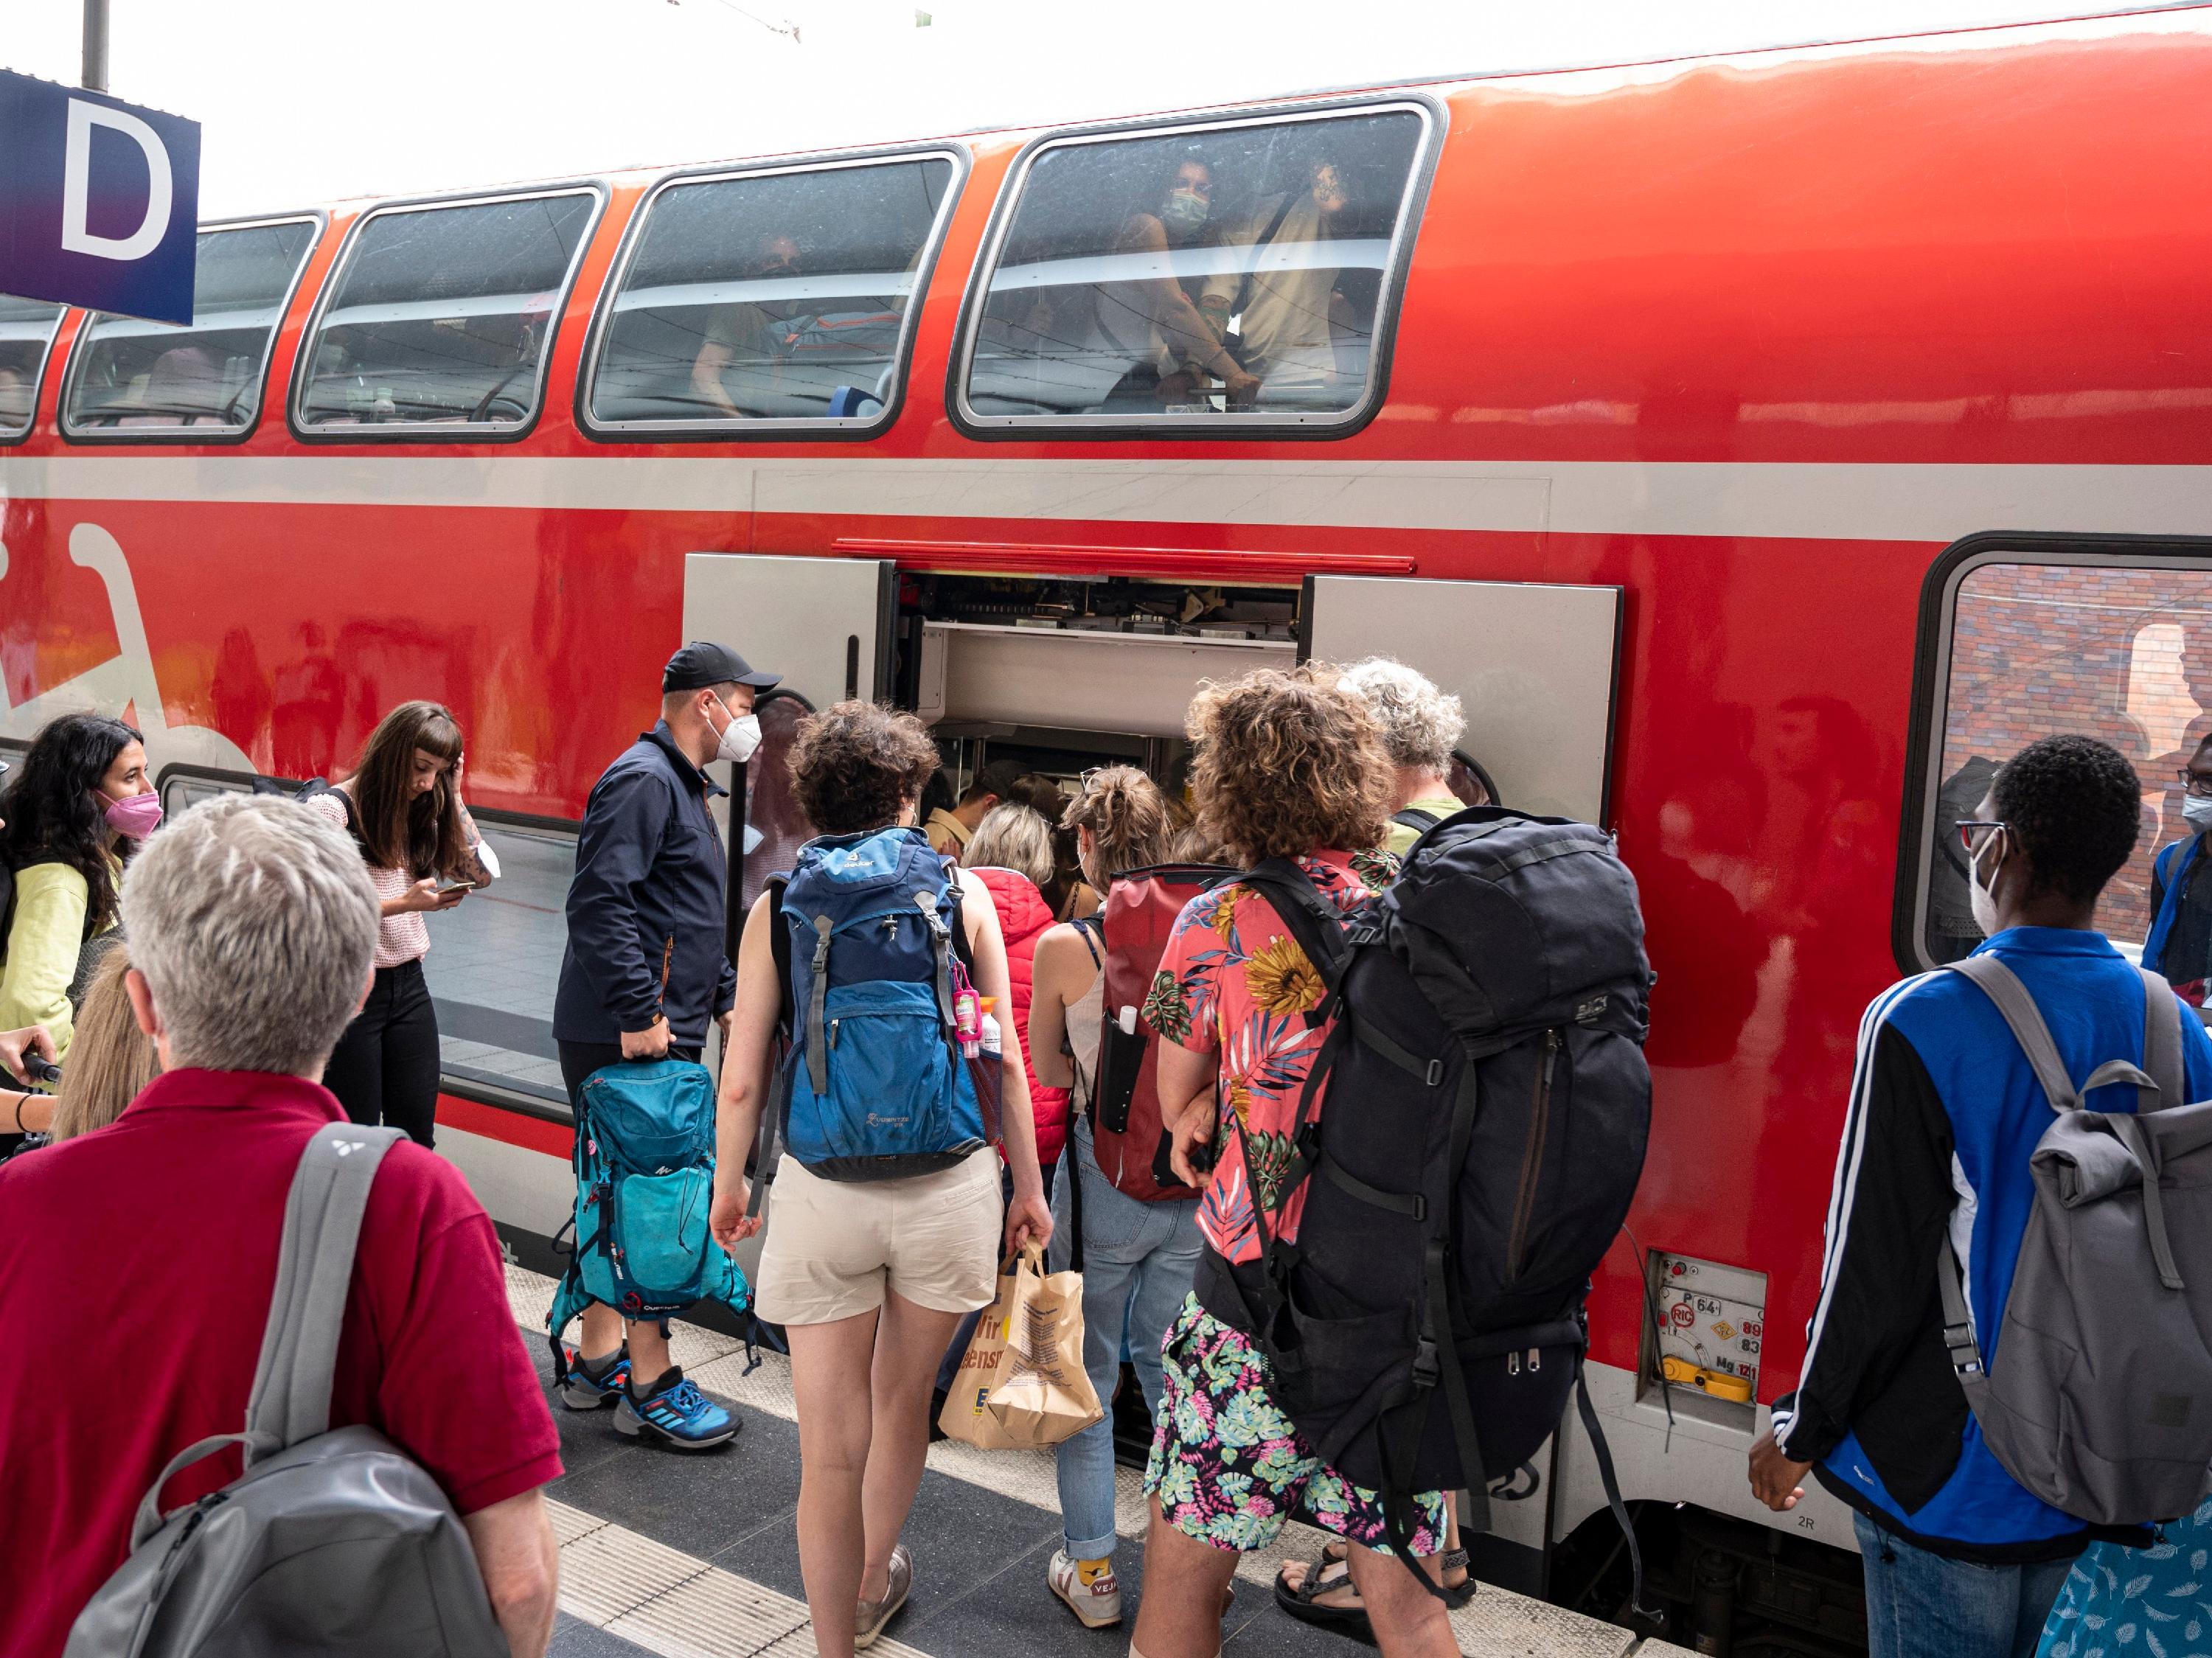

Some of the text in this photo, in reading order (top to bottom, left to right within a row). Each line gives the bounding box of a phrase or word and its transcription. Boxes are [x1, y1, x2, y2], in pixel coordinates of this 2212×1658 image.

[61, 97, 173, 261] D
[1683, 1293, 1716, 1314] P 64
[1673, 1309, 1693, 1322] RIC
[1742, 1321, 1761, 1337] 89
[1741, 1338, 1759, 1354] 83
[1716, 1356, 1734, 1373] Mg
[1798, 1516, 1815, 1530] 2R
